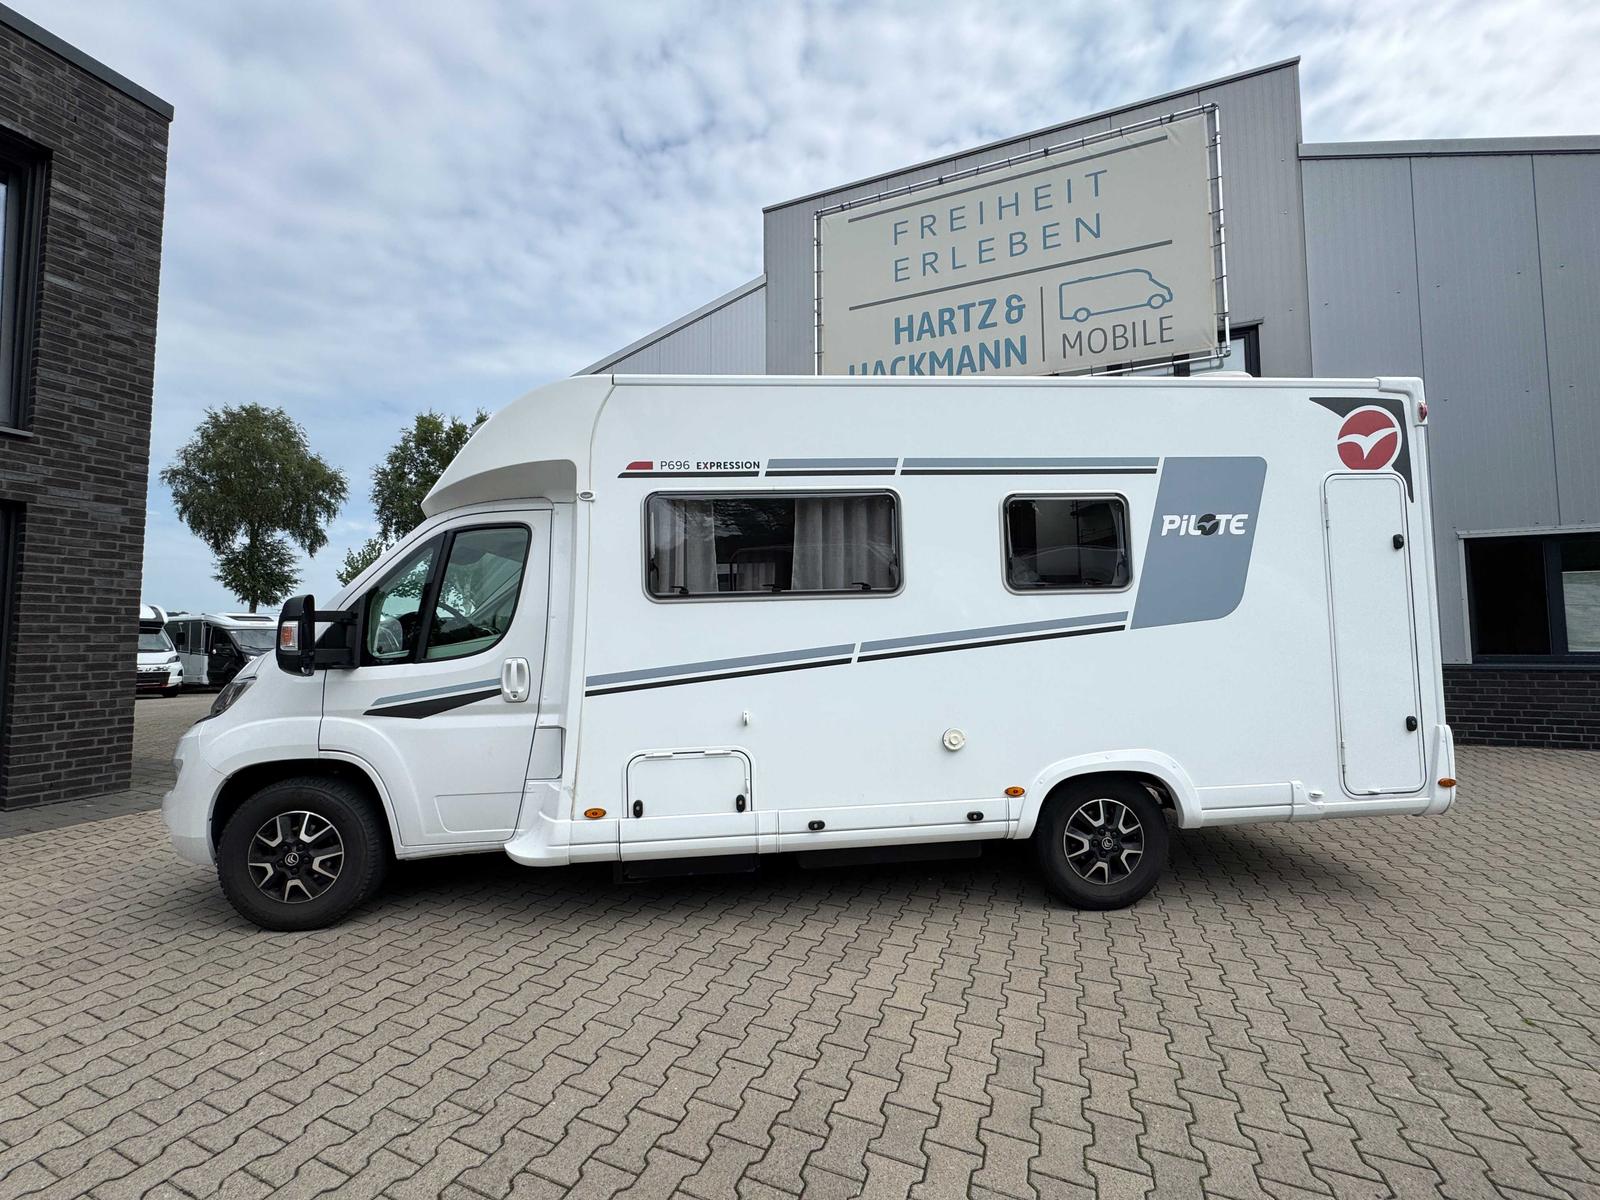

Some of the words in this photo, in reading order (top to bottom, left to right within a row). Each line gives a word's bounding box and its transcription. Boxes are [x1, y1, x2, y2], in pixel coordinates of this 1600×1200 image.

[893, 169, 1107, 246] FREIHEIT
[893, 212, 1101, 282] ERLEBEN
[893, 298, 998, 345] HARTZ
[1004, 293, 1026, 325] &
[1062, 314, 1175, 359] MOBILE
[660, 460, 690, 470] P696
[696, 461, 760, 470] EXPRESSION
